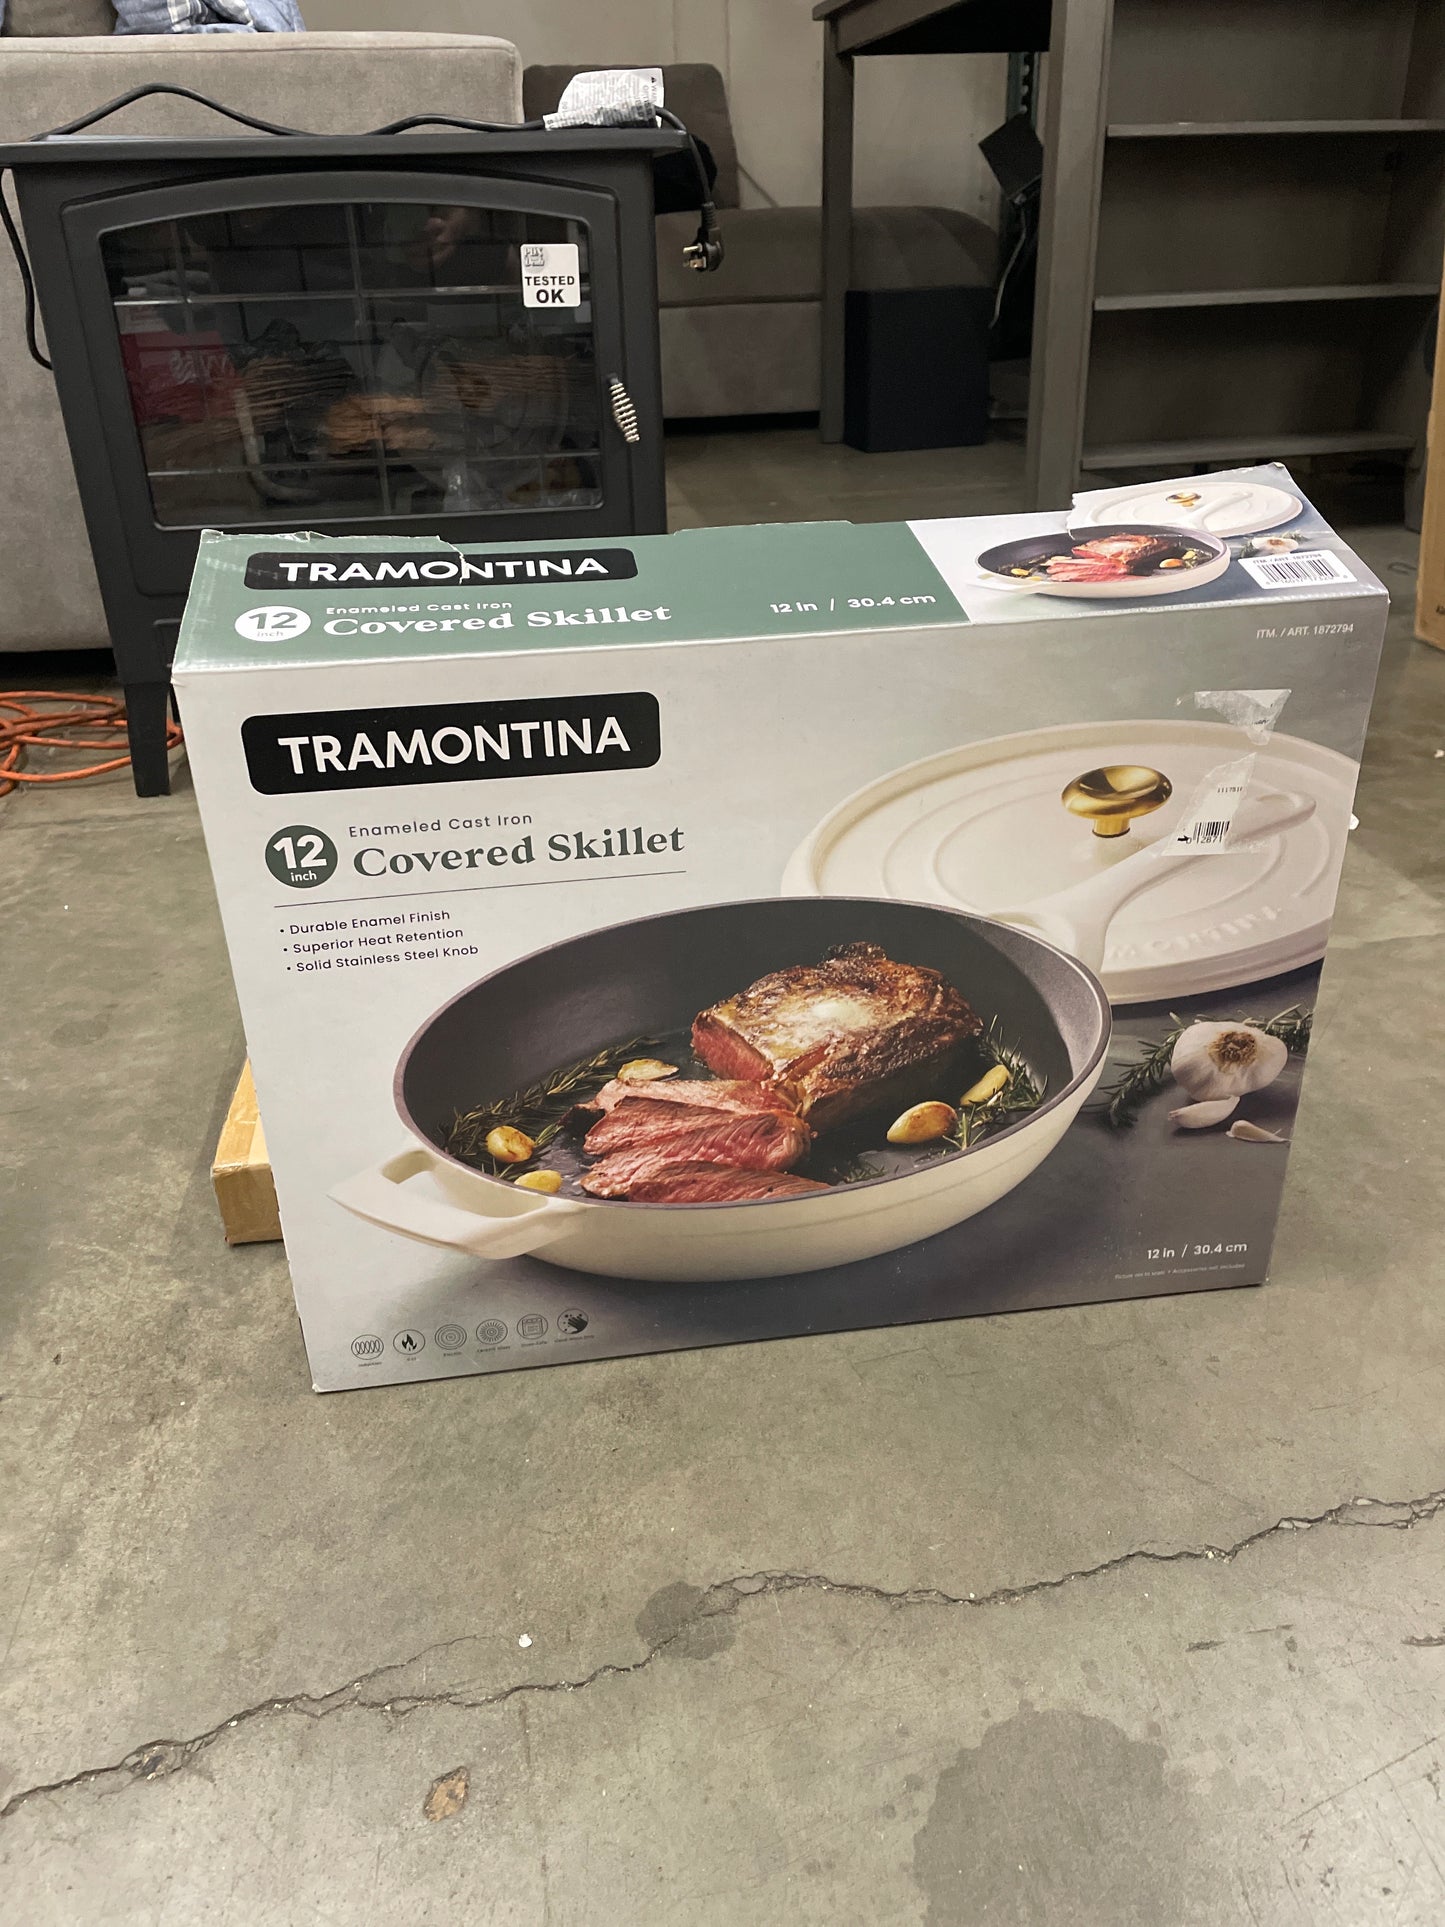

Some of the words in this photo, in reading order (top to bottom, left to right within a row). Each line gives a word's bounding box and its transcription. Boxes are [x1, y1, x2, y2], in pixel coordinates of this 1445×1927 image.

[524, 276, 575, 286] TESTED
[536, 289, 565, 304] OK
[279, 556, 610, 583] TRAMONTINA
[326, 604, 420, 614] Enameled
[427, 602, 470, 611] Cast
[477, 602, 513, 610] Iron
[770, 603, 793, 613] 12
[830, 598, 835, 612] /
[847, 596, 896, 608] 30.4
[899, 595, 937, 604] cm
[249, 611, 299, 629] 12
[323, 612, 515, 636] Covered
[527, 605, 673, 627] Skillet
[1256, 629, 1278, 639] ITM.
[1287, 626, 1310, 637] ART.
[1313, 623, 1355, 635] 1872794
[278, 716, 631, 775] TRAMONTINA
[348, 819, 441, 838] Enameled
[448, 816, 491, 830] Cast
[497, 813, 533, 827] Iron
[272, 834, 328, 870] 12
[353, 836, 536, 877] Covered
[548, 826, 686, 863] Skillet
[290, 869, 317, 883] inch
[290, 920, 347, 935] Durable
[351, 914, 405, 929] Enamel
[409, 910, 450, 923] Finish
[293, 939, 354, 955] Superior
[358, 935, 392, 947] Heat
[396, 929, 464, 943] Retention
[296, 959, 332, 972] Solid
[336, 954, 400, 968] Stainless
[404, 949, 439, 961] Steel
[443, 945, 479, 957] Knob
[1147, 1249, 1159, 1259] 12
[1181, 1244, 1188, 1258] /
[1194, 1244, 1222, 1255] 30.4
[1225, 1243, 1248, 1253] cm
